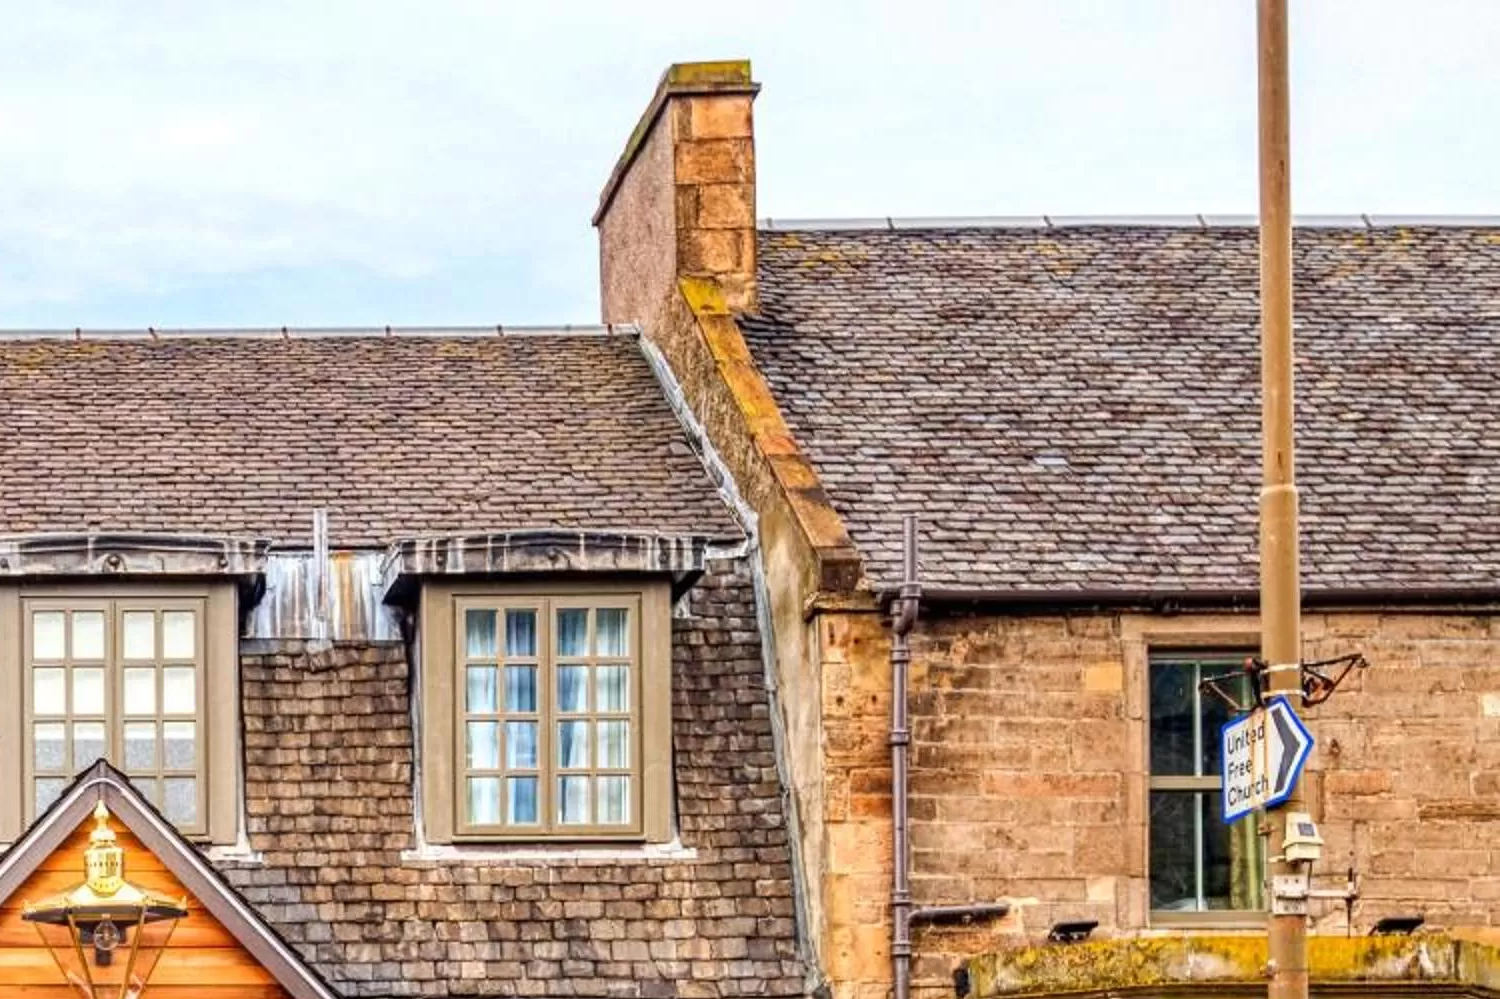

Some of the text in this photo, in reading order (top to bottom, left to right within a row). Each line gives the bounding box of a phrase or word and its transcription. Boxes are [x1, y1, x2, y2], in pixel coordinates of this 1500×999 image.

[1227, 722, 1265, 755] United
[1227, 760, 1252, 779] Free
[1228, 775, 1269, 806] Church
